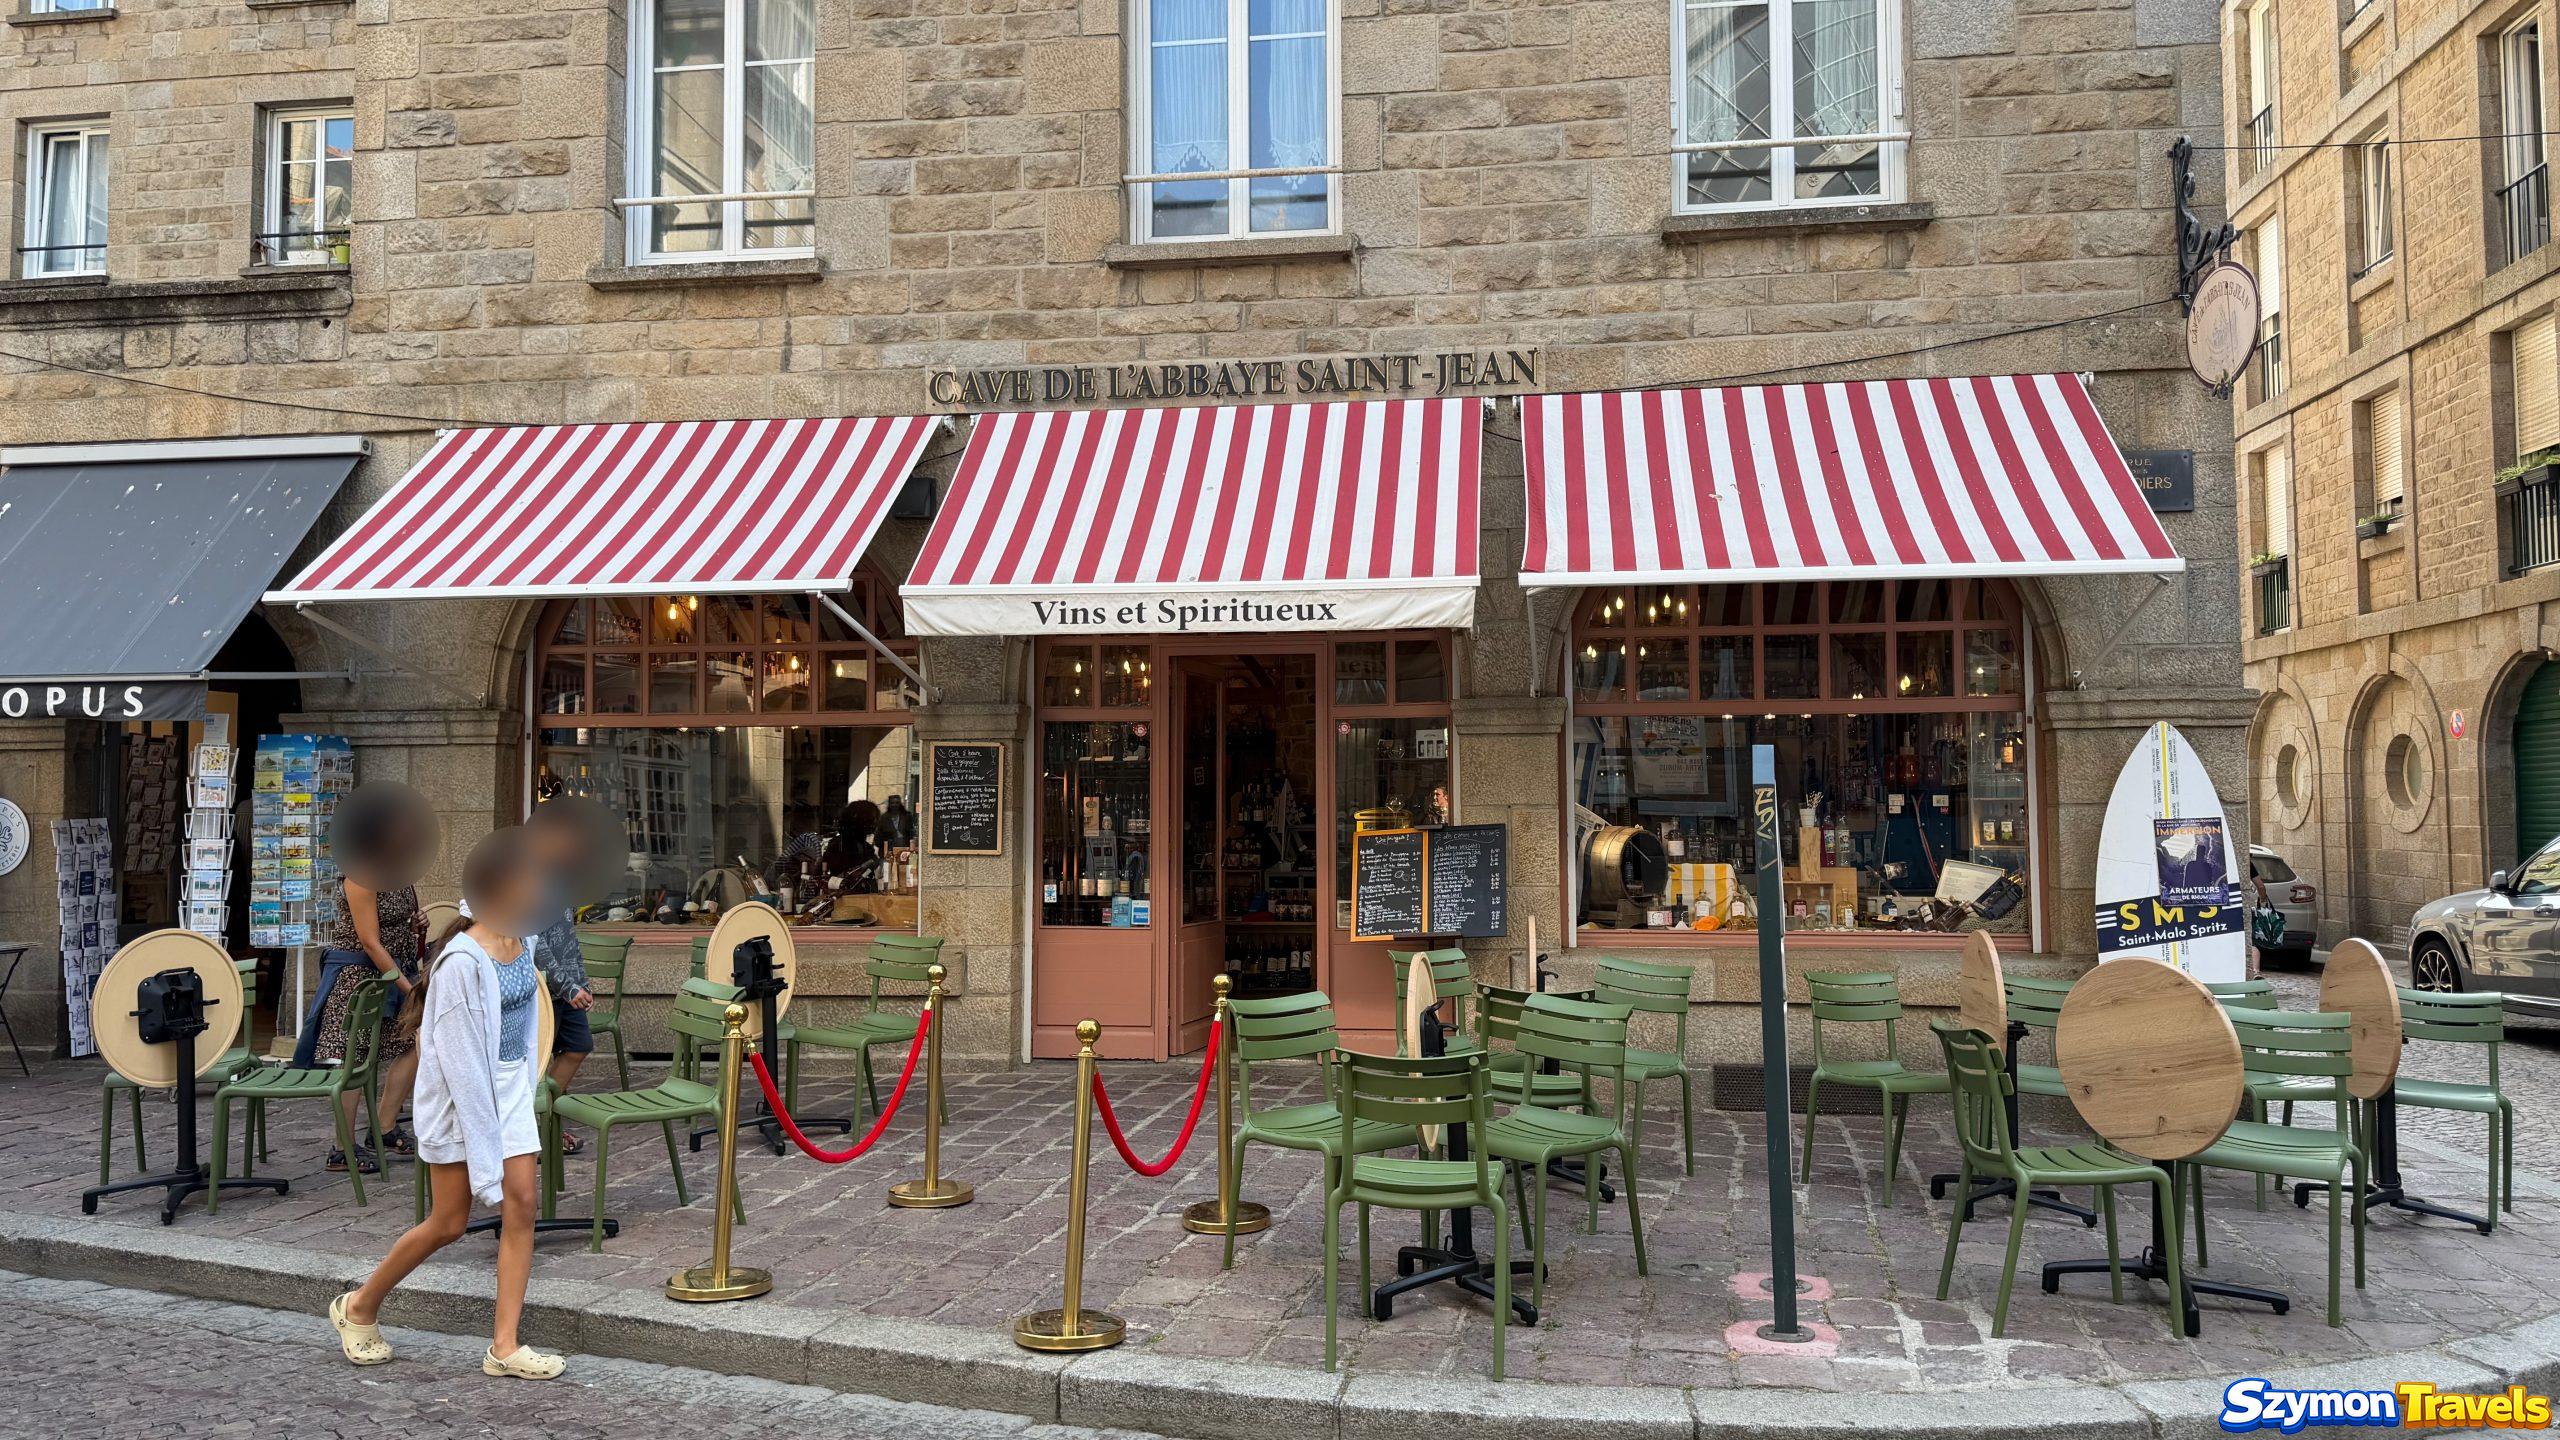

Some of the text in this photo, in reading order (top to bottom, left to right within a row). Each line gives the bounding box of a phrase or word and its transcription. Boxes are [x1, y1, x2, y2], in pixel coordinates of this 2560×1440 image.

[929, 350, 1539, 406] CAVE DE L'ABBAYE SAINT-JEAN
[2128, 459, 2152, 467] RUE
[2137, 476, 2172, 490] DIERS
[1032, 598, 1337, 631] Vins et Spiritueux
[2156, 825, 2221, 836] IMMERSION
[2169, 886, 2220, 895] ARMATEURS
[2118, 922, 2228, 947] Saint-Malo Spritz
